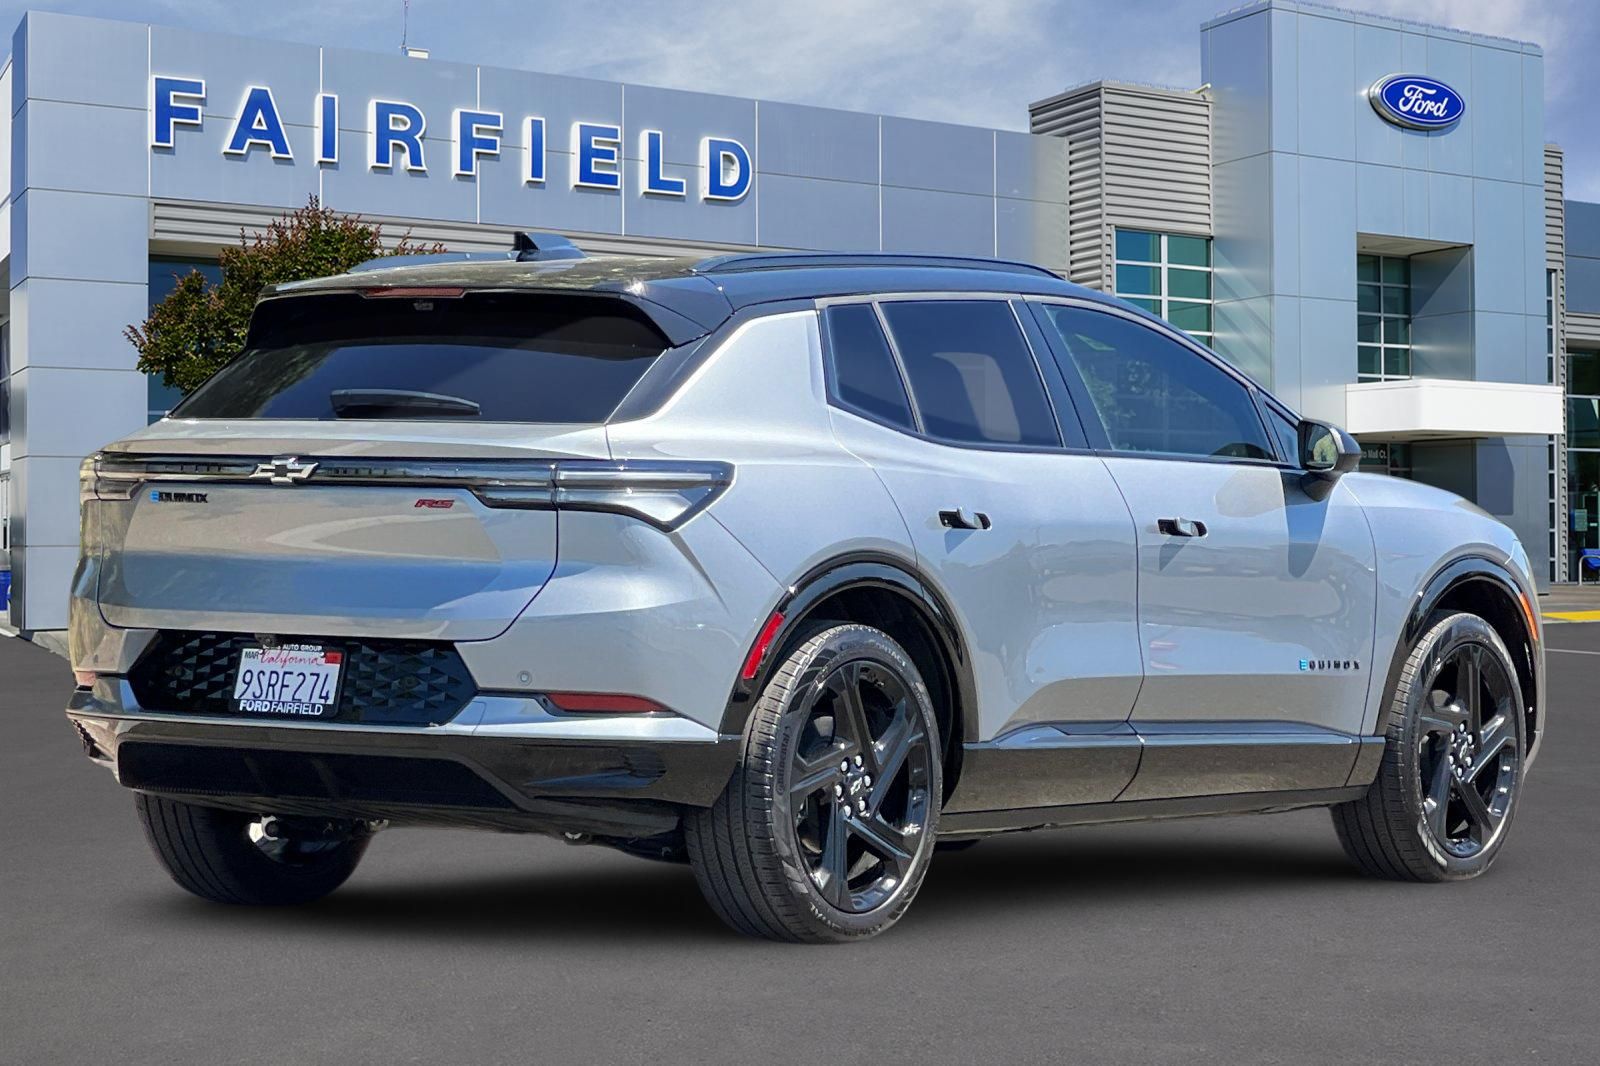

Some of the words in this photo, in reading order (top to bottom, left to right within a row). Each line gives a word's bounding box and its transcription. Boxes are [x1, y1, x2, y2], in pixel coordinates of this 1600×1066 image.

[1398, 84, 1449, 117] Ford
[150, 74, 754, 201] FAIRFIELD
[414, 499, 455, 509] RS
[260, 648, 323, 668] California
[1299, 659, 1360, 671] EQUINOX
[238, 669, 330, 704] 9SRF274
[239, 700, 270, 712] FORD
[270, 701, 323, 716] FAIRFIELD
